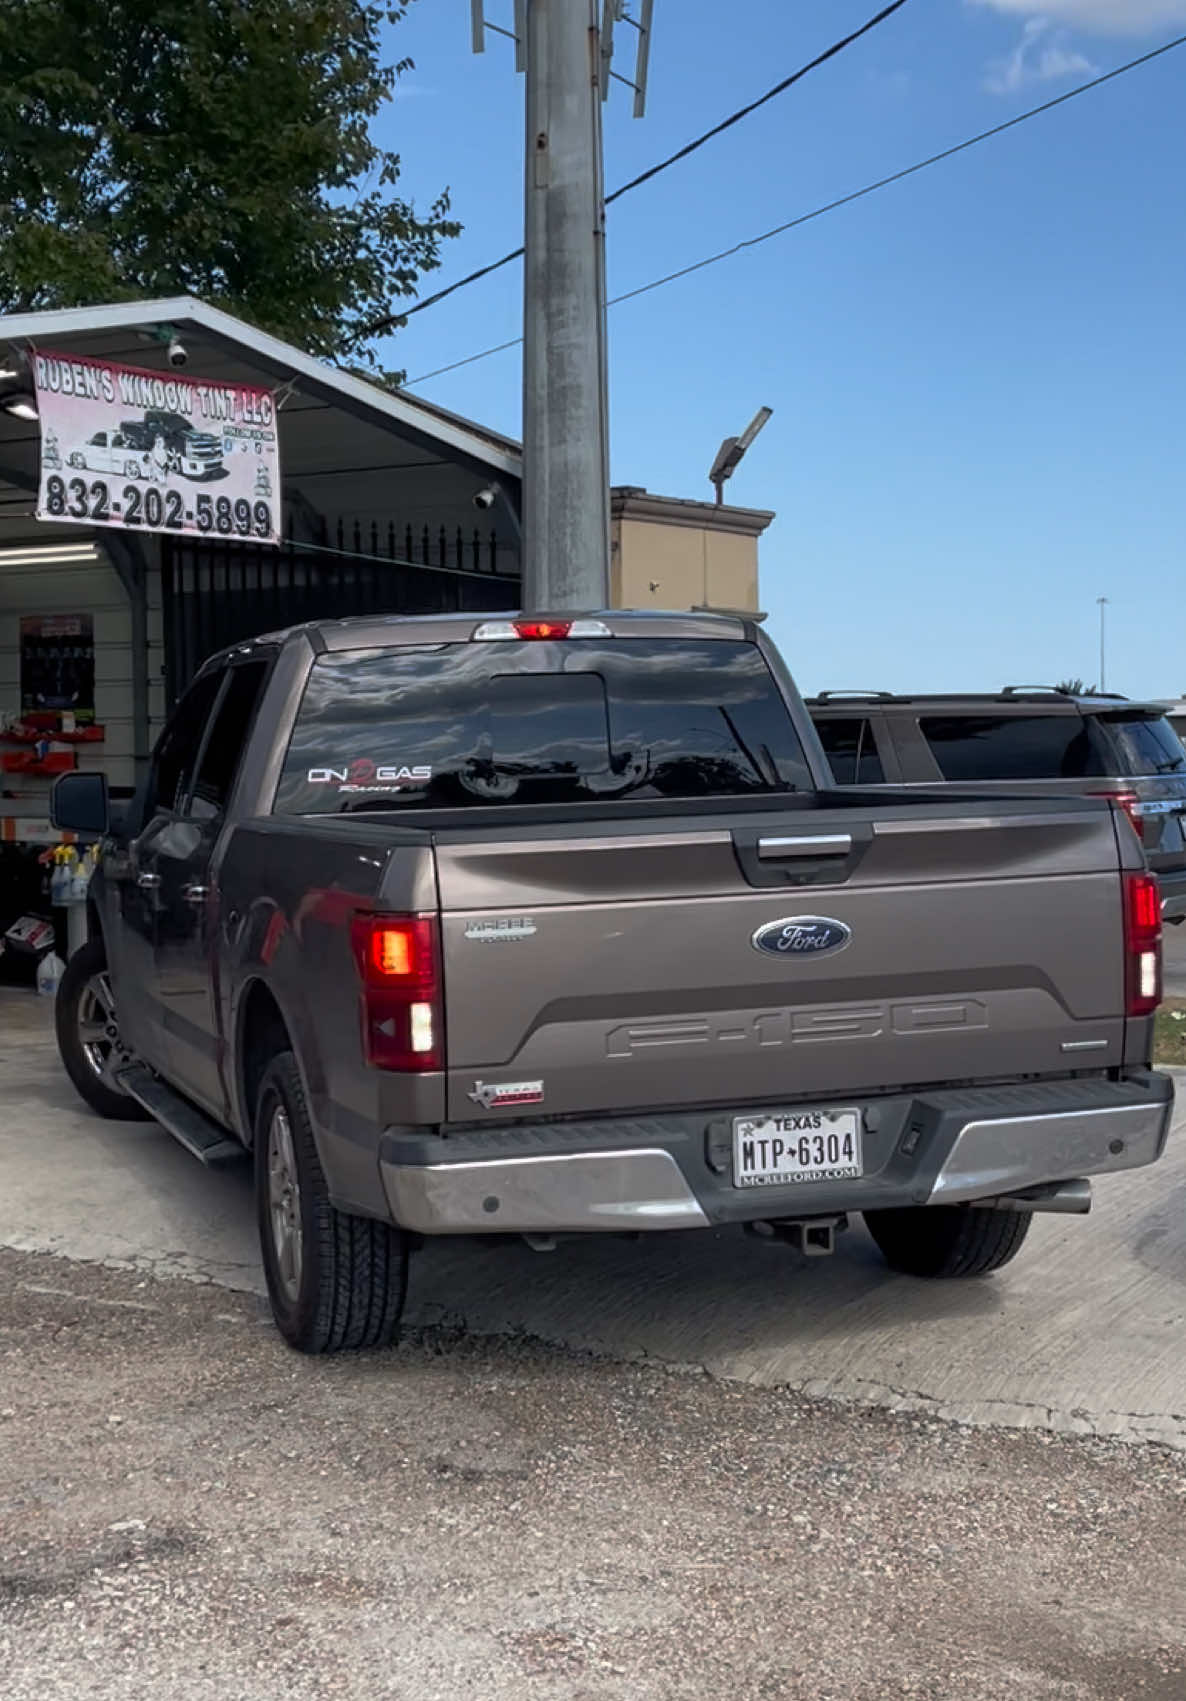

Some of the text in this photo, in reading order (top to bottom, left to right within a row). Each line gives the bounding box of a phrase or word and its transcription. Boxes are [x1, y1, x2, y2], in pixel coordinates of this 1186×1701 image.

[36, 357, 272, 426] RUBEN'S WINDOW TINT LLC
[46, 475, 271, 538] 832-202-5899
[777, 926, 830, 950] Ford
[605, 999, 988, 1059] F-150
[774, 1114, 821, 1132] TEXAS
